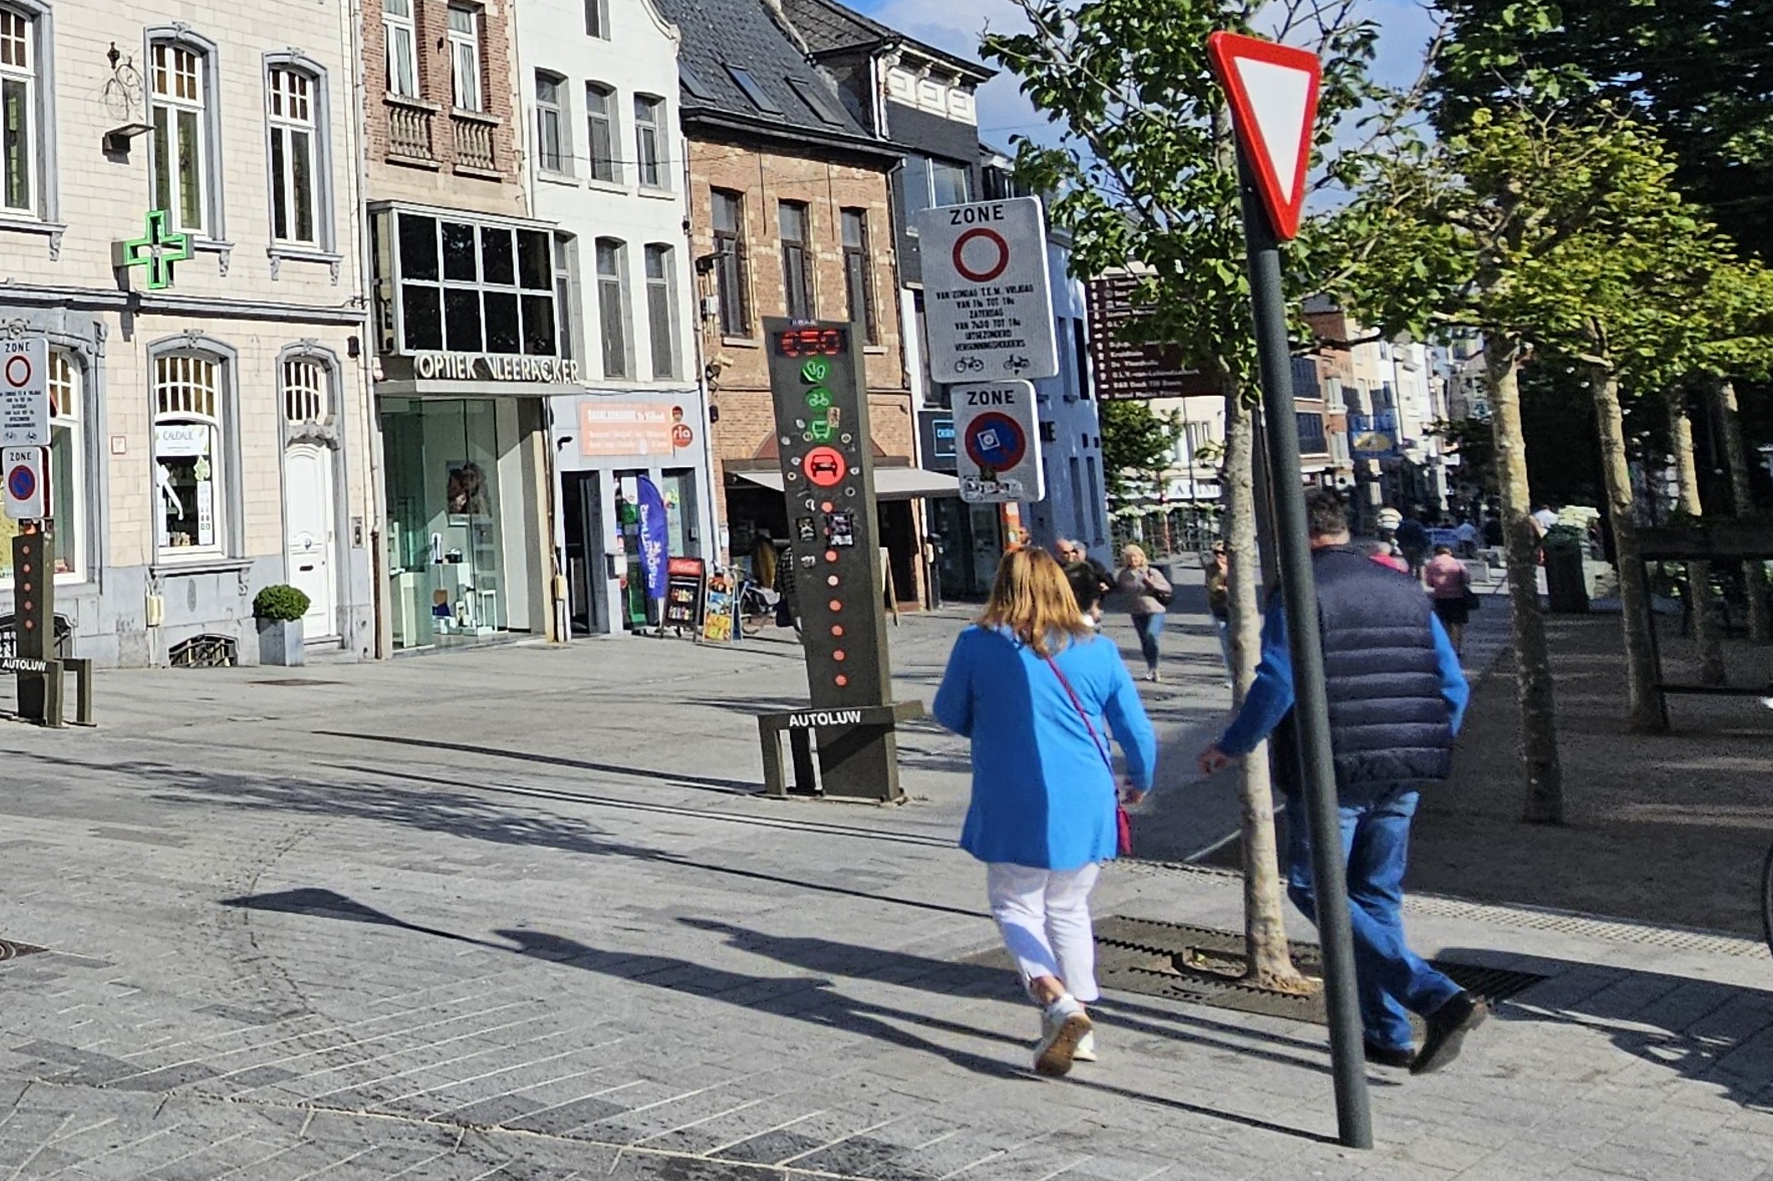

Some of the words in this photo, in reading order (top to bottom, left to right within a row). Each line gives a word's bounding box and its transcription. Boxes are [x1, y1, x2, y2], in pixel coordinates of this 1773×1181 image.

[949, 204, 1005, 225] ZONE
[936, 292, 950, 300] VAN
[952, 289, 978, 298] ZONDAG
[1005, 284, 1034, 293] VRIJDAG
[956, 300, 970, 309] VAN
[986, 297, 999, 306] TOT
[969, 308, 1003, 319] ZATERDAG
[954, 322, 969, 330] VAN
[993, 319, 1005, 328] TOT
[965, 330, 1012, 340] UITGEZONDERD
[5, 342, 31, 353] ZONE
[417, 354, 477, 379] OPTIEK
[485, 356, 579, 385] VLEERACKER
[966, 390, 1015, 406] ZONE
[9, 451, 32, 462] ZONE
[2, 659, 47, 672] AUTOLUW
[789, 710, 861, 727] AUTOLUW
